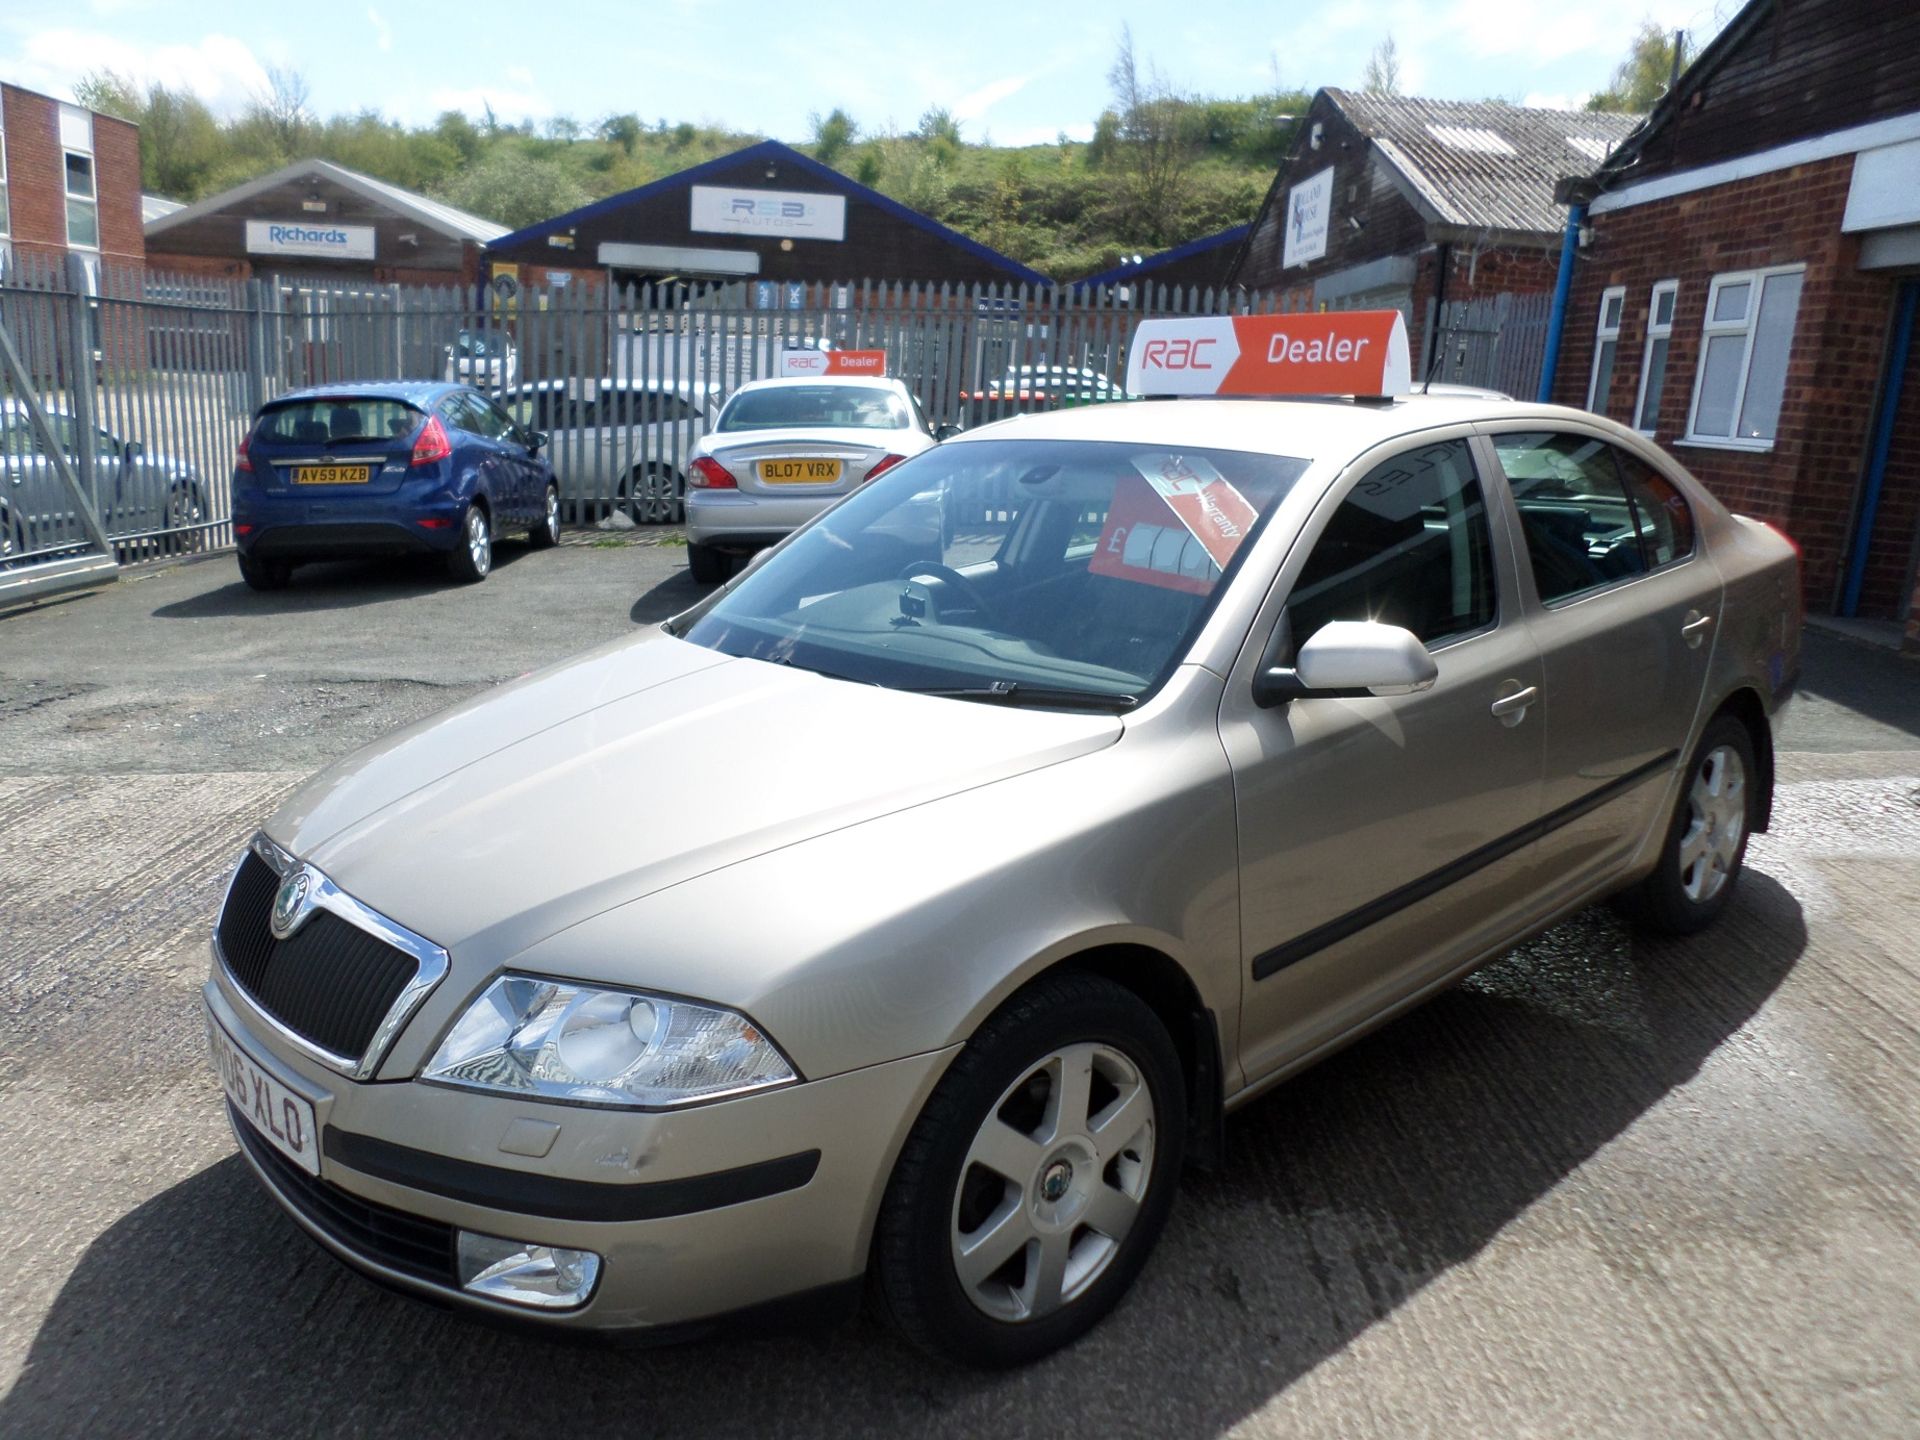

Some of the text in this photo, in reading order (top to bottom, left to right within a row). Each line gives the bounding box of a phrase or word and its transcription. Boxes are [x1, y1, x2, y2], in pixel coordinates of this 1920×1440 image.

[742, 217, 794, 227] AUTOS
[269, 226, 348, 245] Richards
[1267, 331, 1370, 365] Dealer
[840, 356, 879, 368] Dealer
[300, 466, 337, 482] AV59
[340, 465, 367, 481] KZB
[765, 462, 835, 478] BL07 VRX
